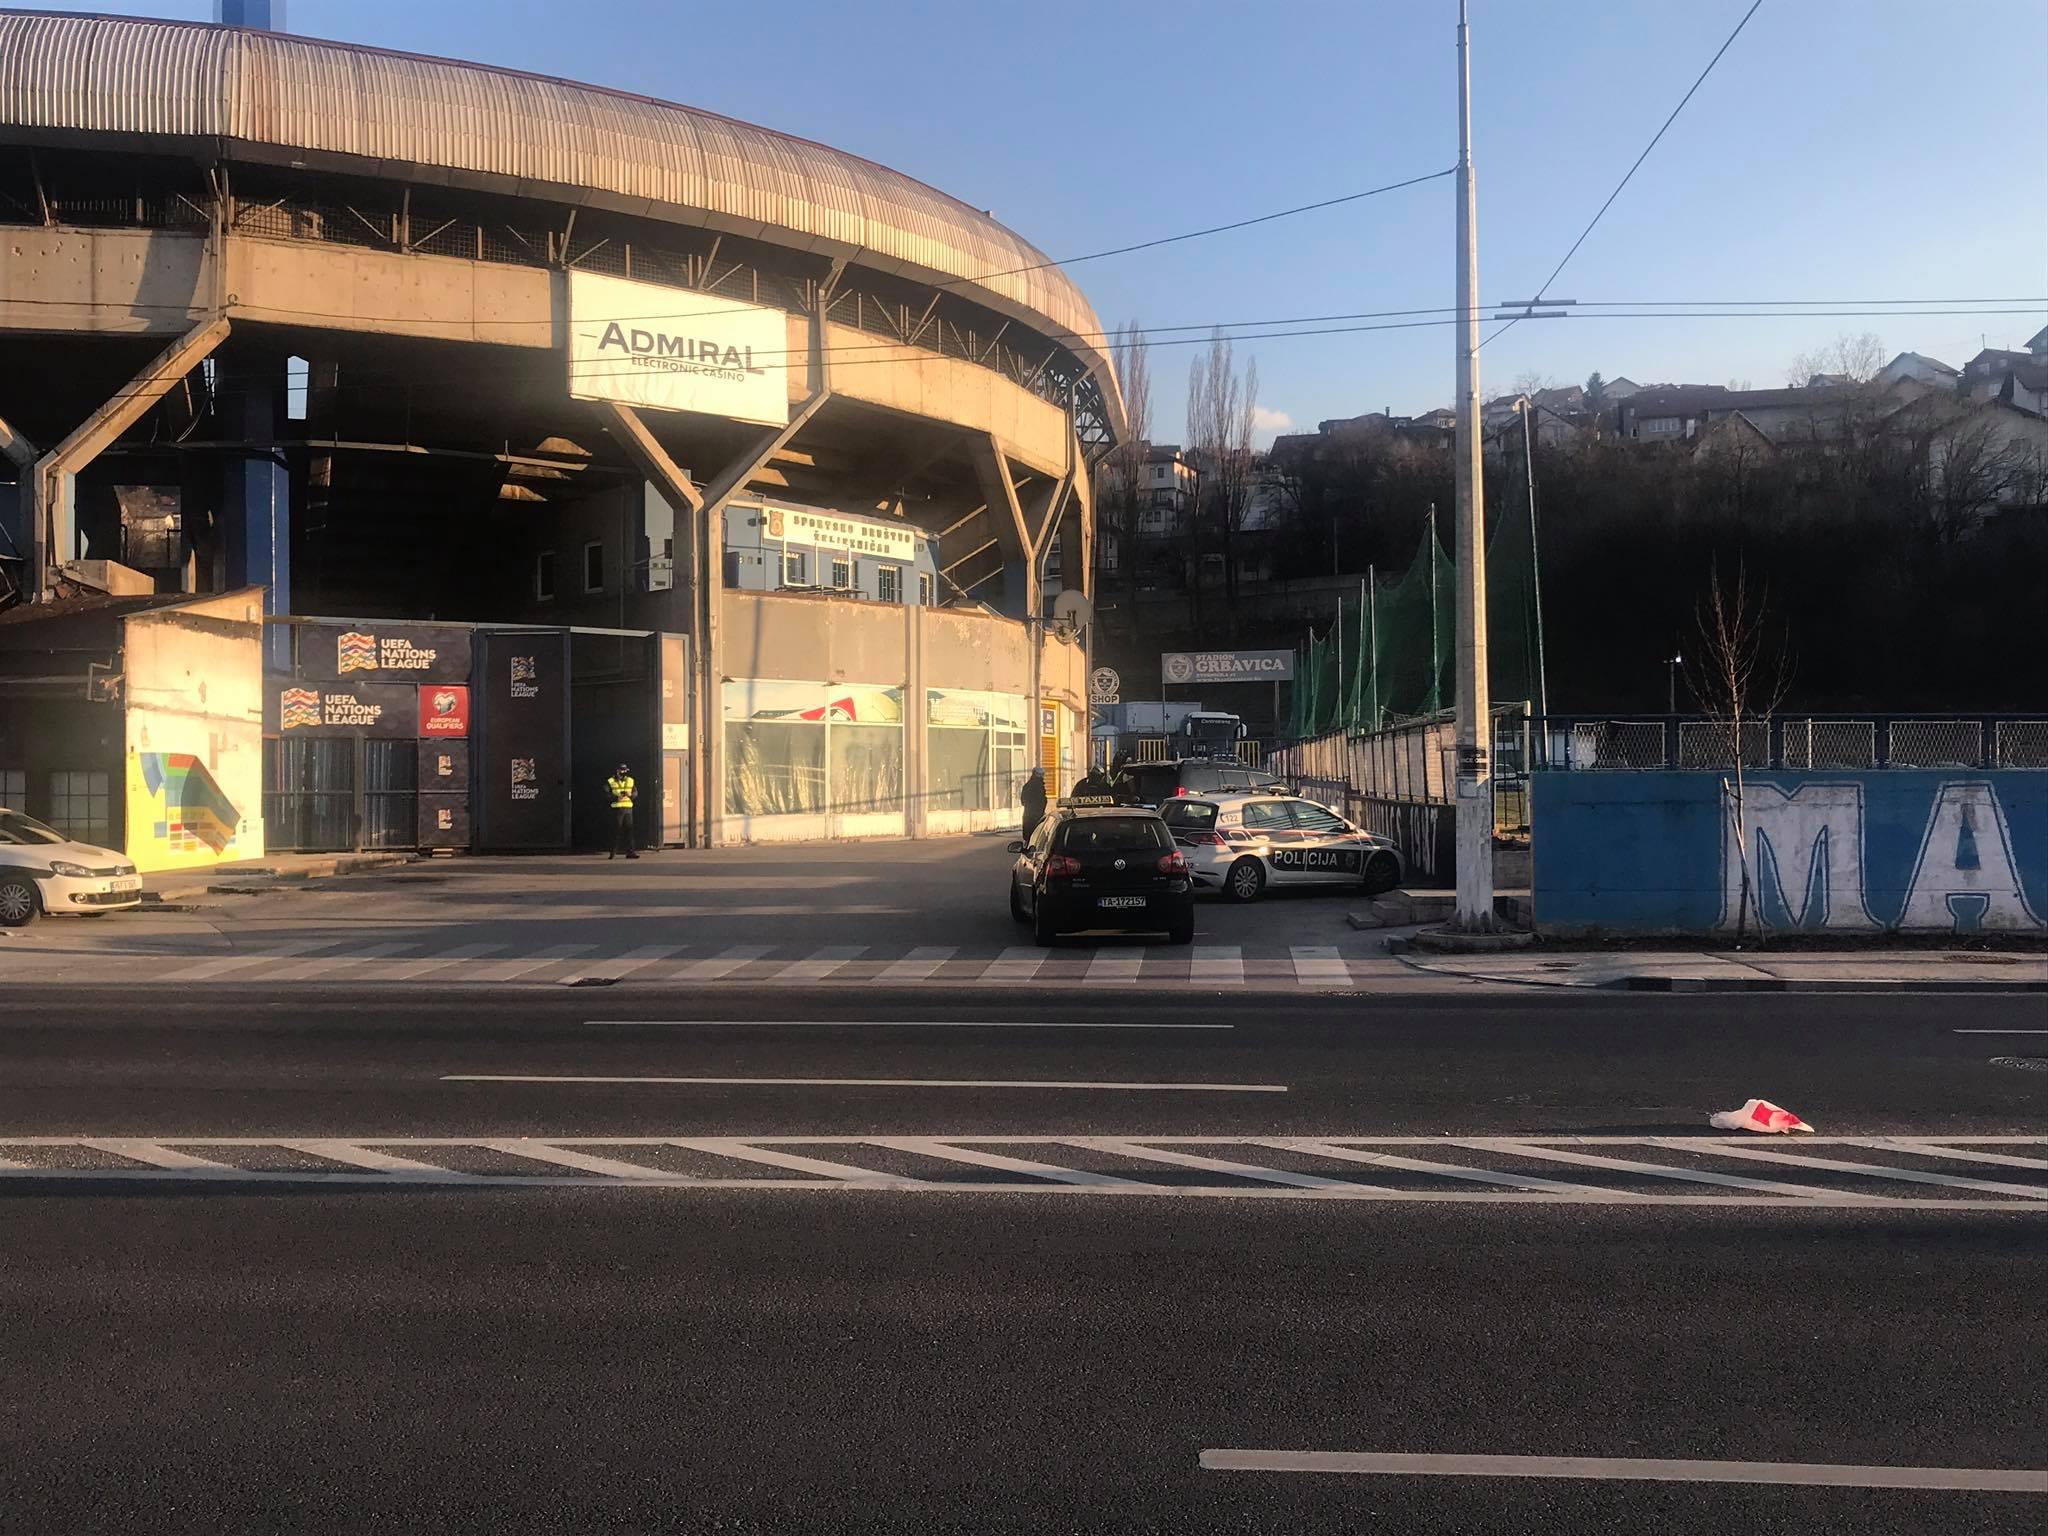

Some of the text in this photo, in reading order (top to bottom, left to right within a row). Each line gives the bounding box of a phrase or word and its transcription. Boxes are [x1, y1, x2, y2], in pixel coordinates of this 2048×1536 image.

[598, 322, 765, 375] ADMIRAL
[631, 356, 745, 382] ELECTRONIC CASINO
[381, 638, 412, 649] UEFA
[381, 649, 436, 660] NATIONS
[381, 659, 430, 669] LEAGUE
[1195, 658, 1285, 673] GRBAVICA
[325, 695, 357, 705] UEFA
[1091, 695, 1118, 703] SHOP
[325, 704, 382, 716] NATIONS
[325, 714, 376, 725] LEAGUE
[426, 722, 464, 730] QUALIFIERS
[1079, 795, 1102, 804] TAXI
[1225, 813, 1239, 822] 122
[1273, 850, 1338, 866] POLICIJA
